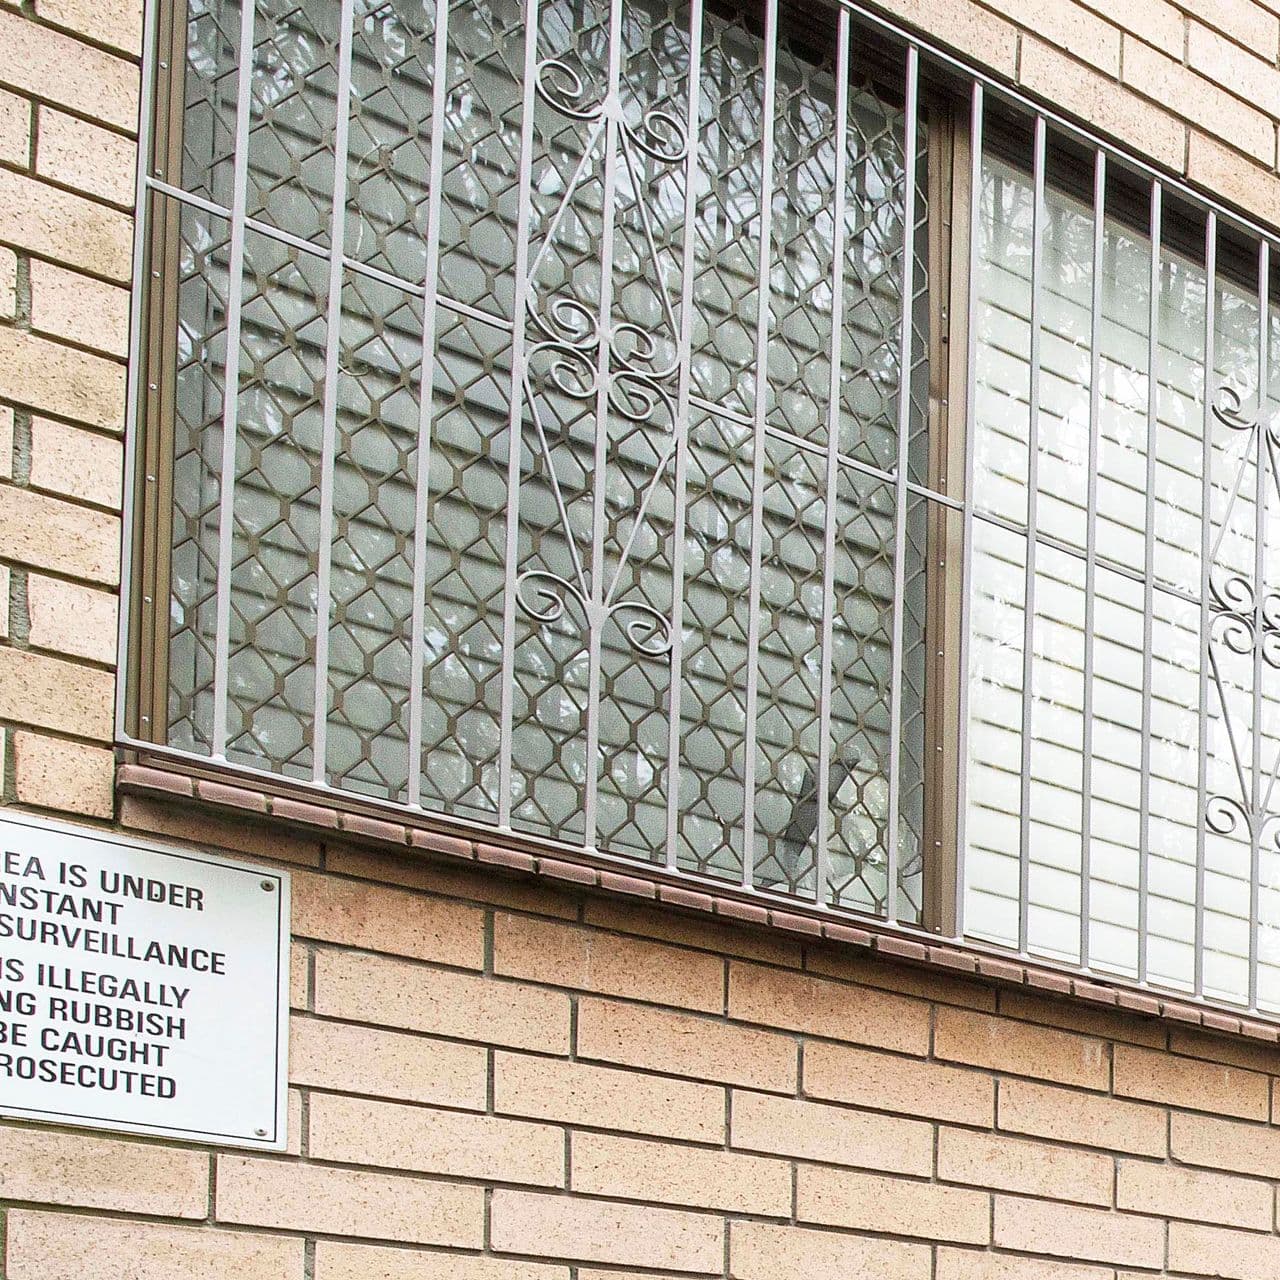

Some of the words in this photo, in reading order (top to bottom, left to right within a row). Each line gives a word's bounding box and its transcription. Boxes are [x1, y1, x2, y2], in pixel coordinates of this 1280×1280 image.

[0, 850, 46, 880] EA
[59, 862, 88, 888] IS
[101, 870, 205, 911] UNDER
[0, 913, 226, 975] SURVEILLANCE
[38, 963, 190, 1009] ILLEGALLY
[49, 997, 187, 1040] RUBBISH
[41, 1027, 170, 1067] CAUGHT
